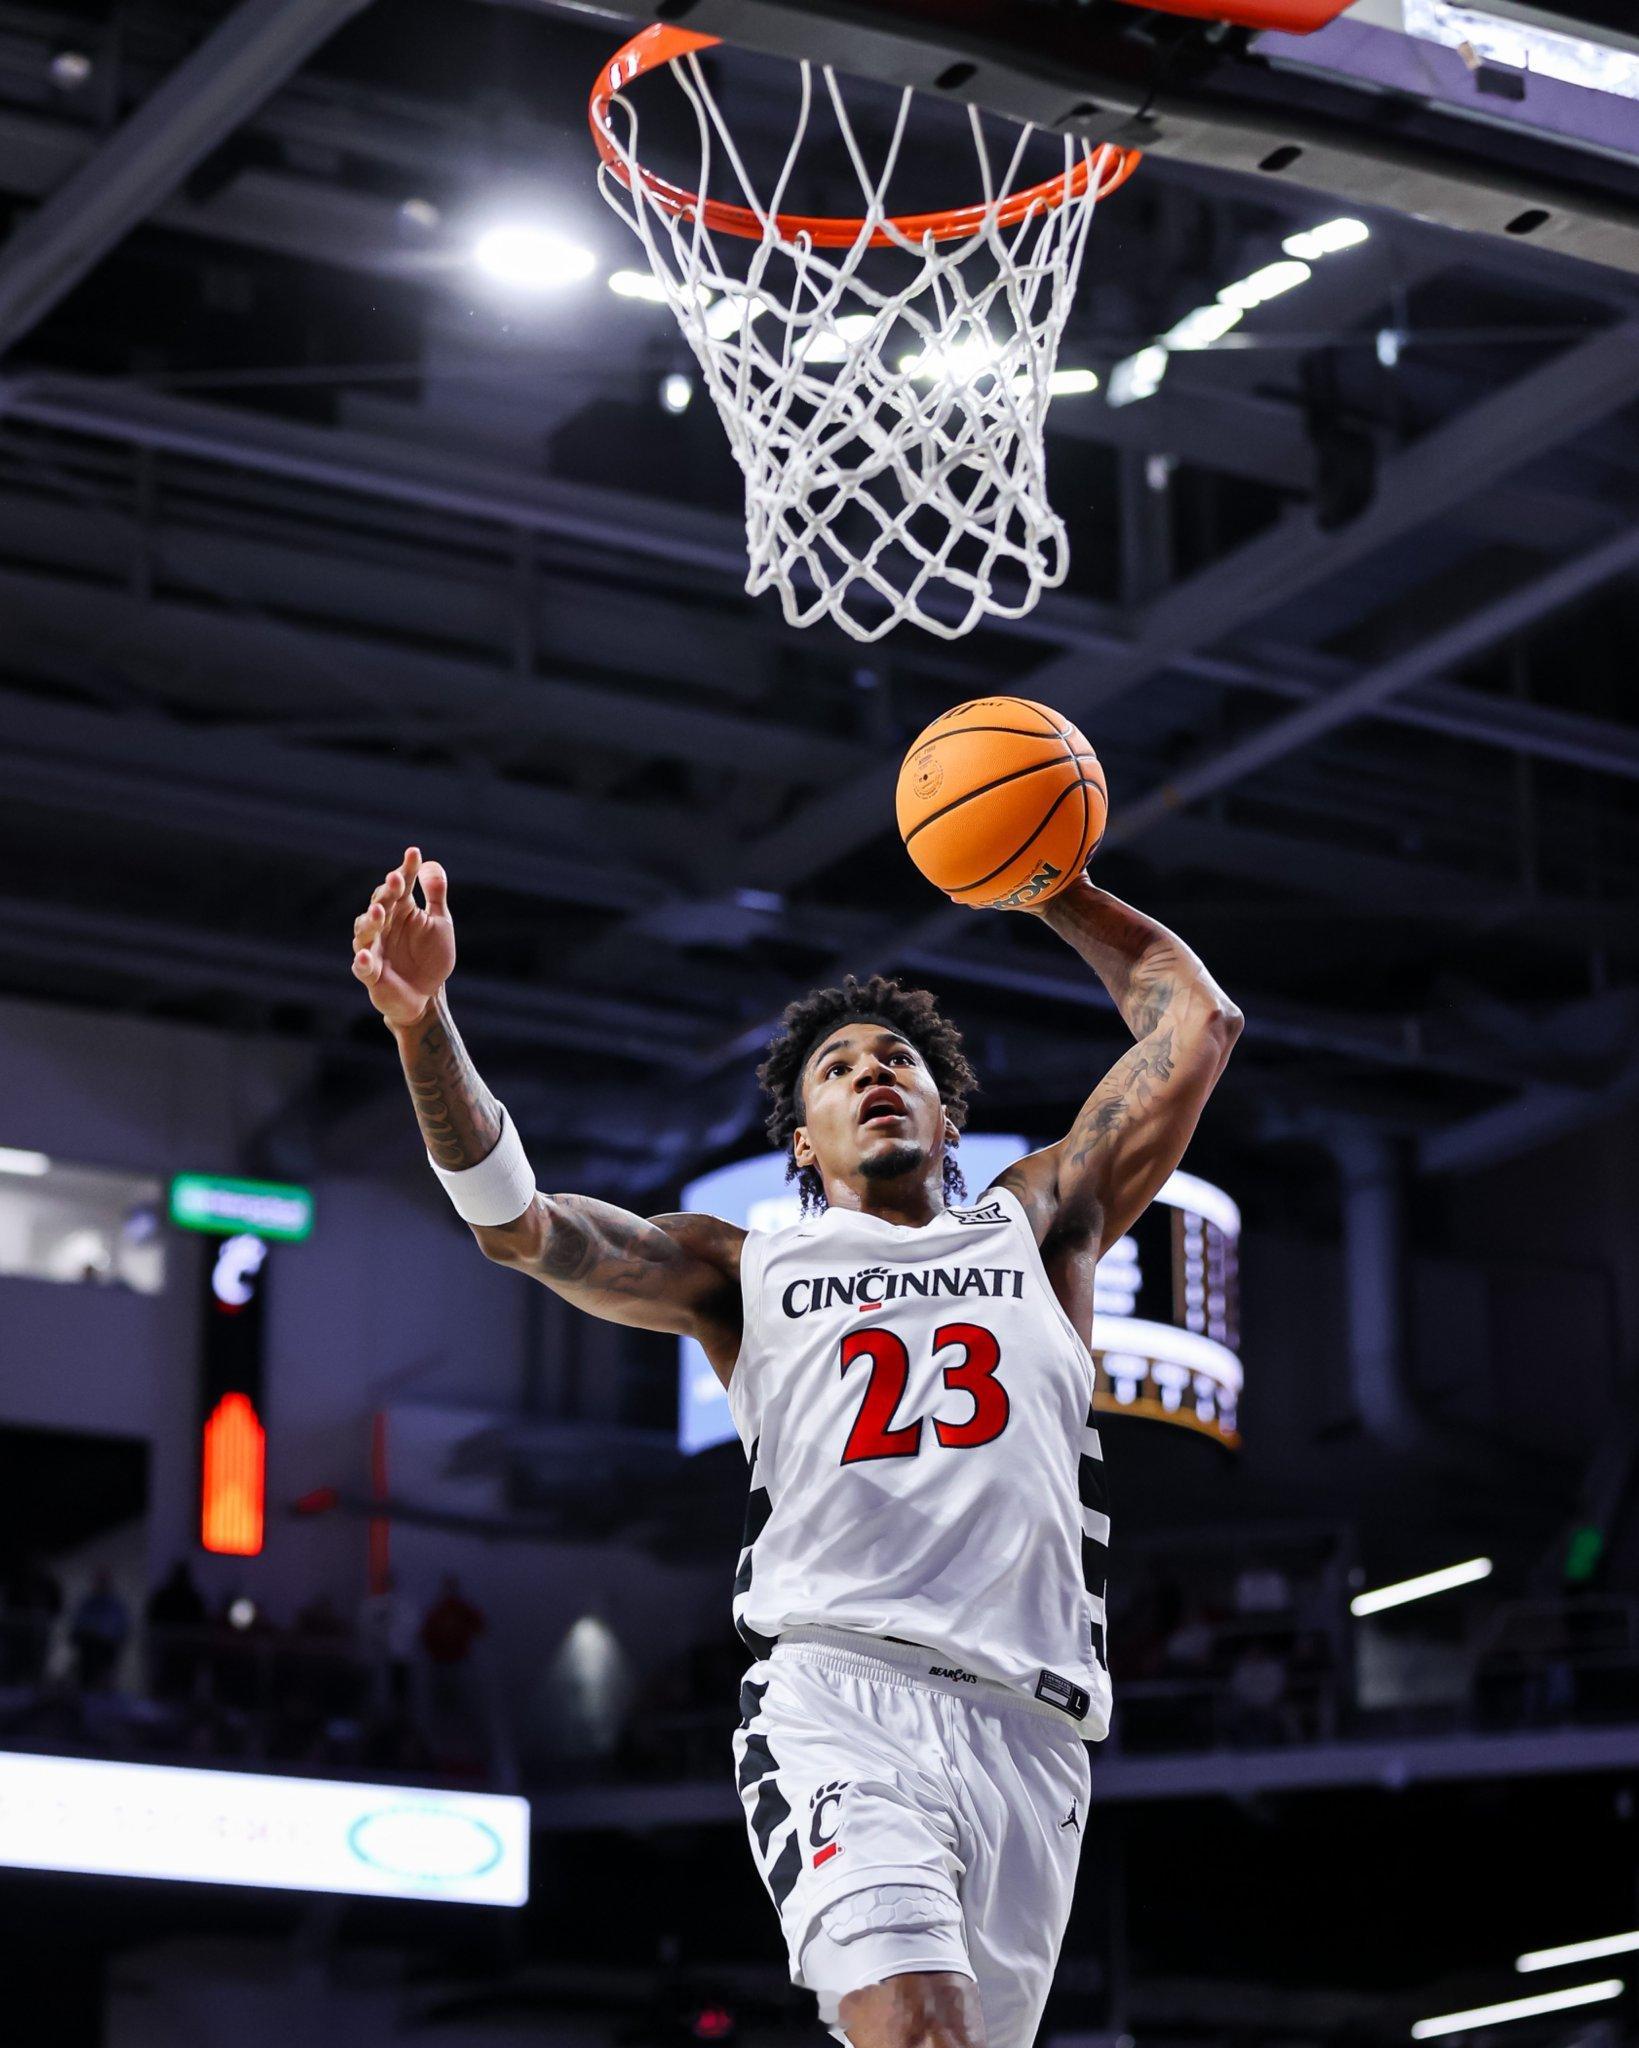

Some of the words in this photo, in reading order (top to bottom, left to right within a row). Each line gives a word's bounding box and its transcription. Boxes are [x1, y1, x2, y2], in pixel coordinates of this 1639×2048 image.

[782, 1266, 1025, 1319] CINCINNATI
[840, 1322, 1010, 1466] 23
[928, 1666, 978, 1684] BEARCATS
